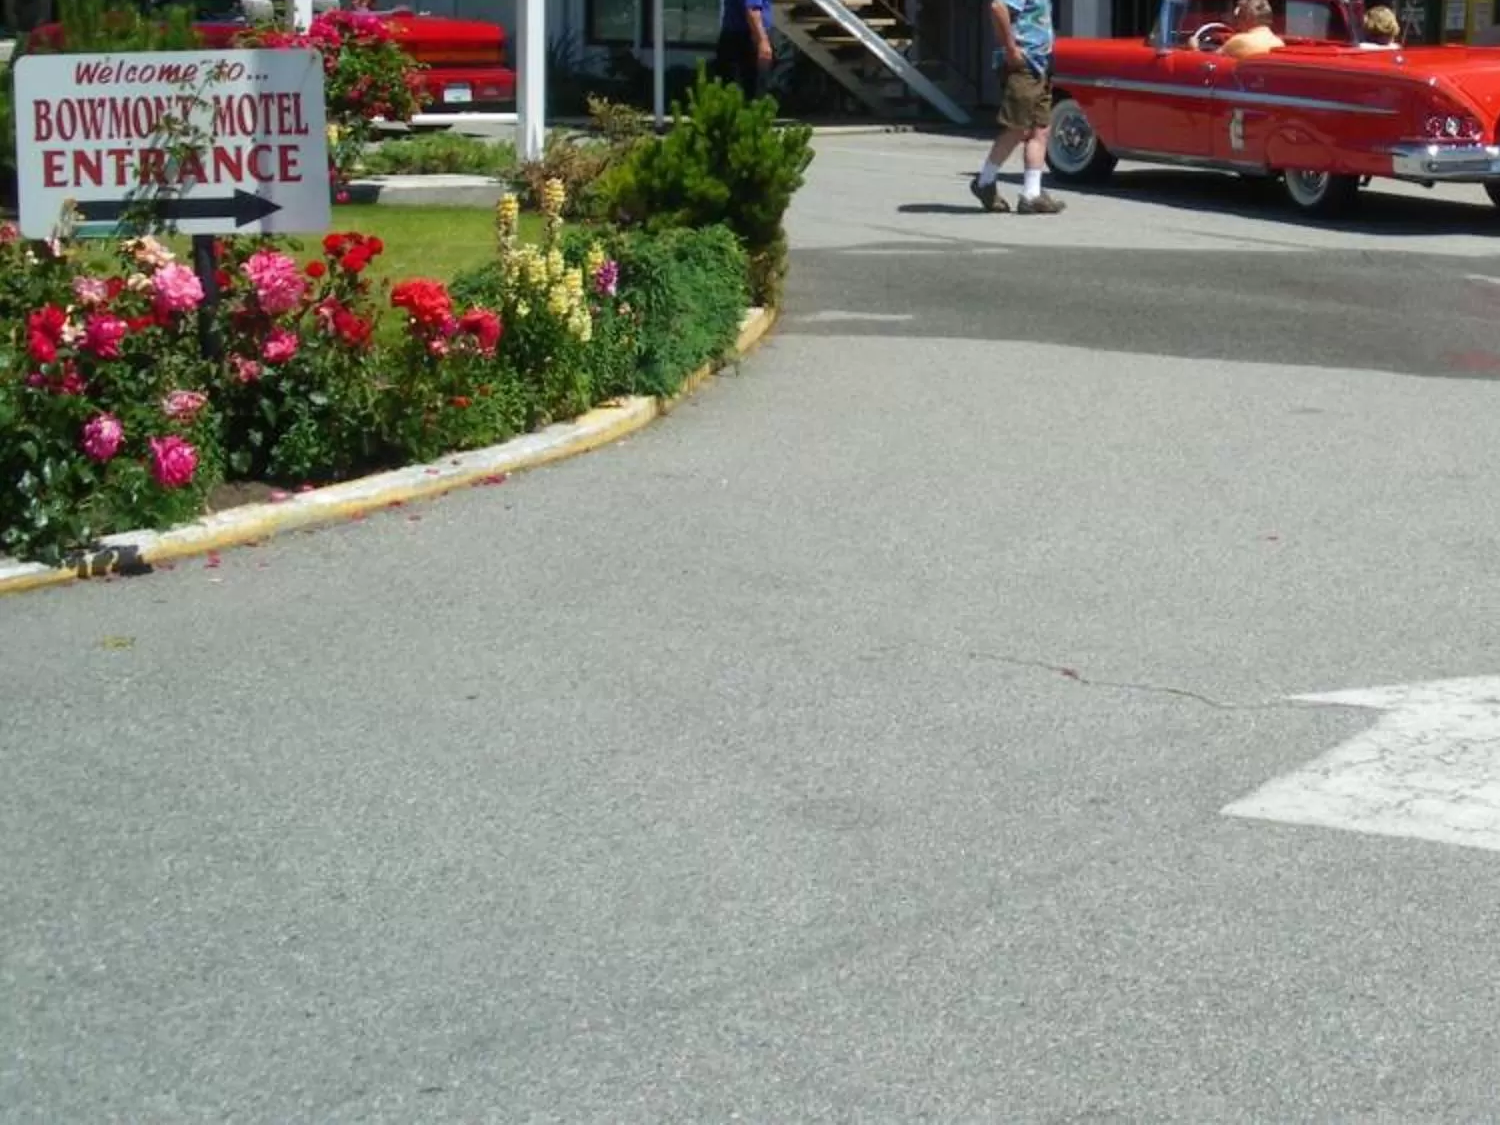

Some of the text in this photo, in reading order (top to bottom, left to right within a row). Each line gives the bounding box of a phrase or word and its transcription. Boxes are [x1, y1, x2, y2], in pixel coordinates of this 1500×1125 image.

[75, 60, 198, 85] Welcome
[33, 92, 309, 142] BOWMONT MOTEL
[42, 144, 303, 189] ENTRANCE
